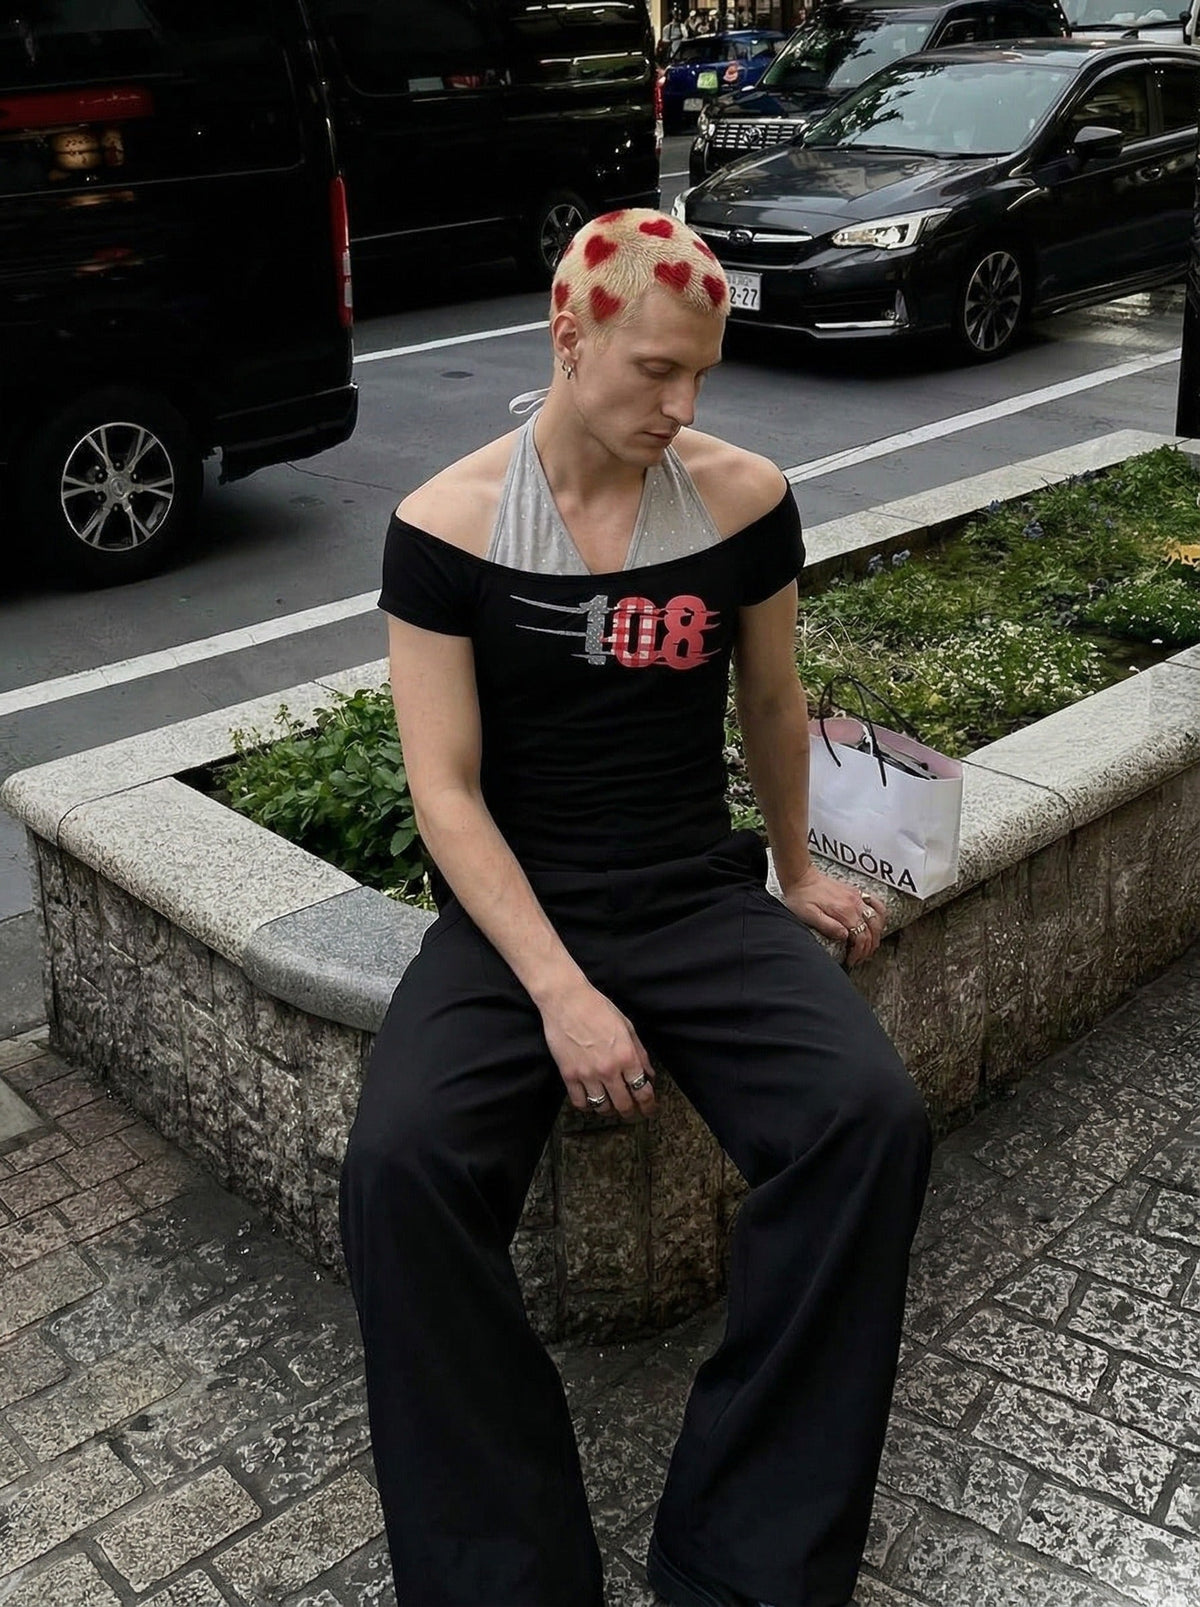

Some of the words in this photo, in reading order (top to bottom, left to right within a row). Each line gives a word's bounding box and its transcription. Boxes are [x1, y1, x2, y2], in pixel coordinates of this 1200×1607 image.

[729, 286, 758, 307] 2-27
[578, 594, 708, 670] 108
[808, 827, 918, 893] ANDORA
